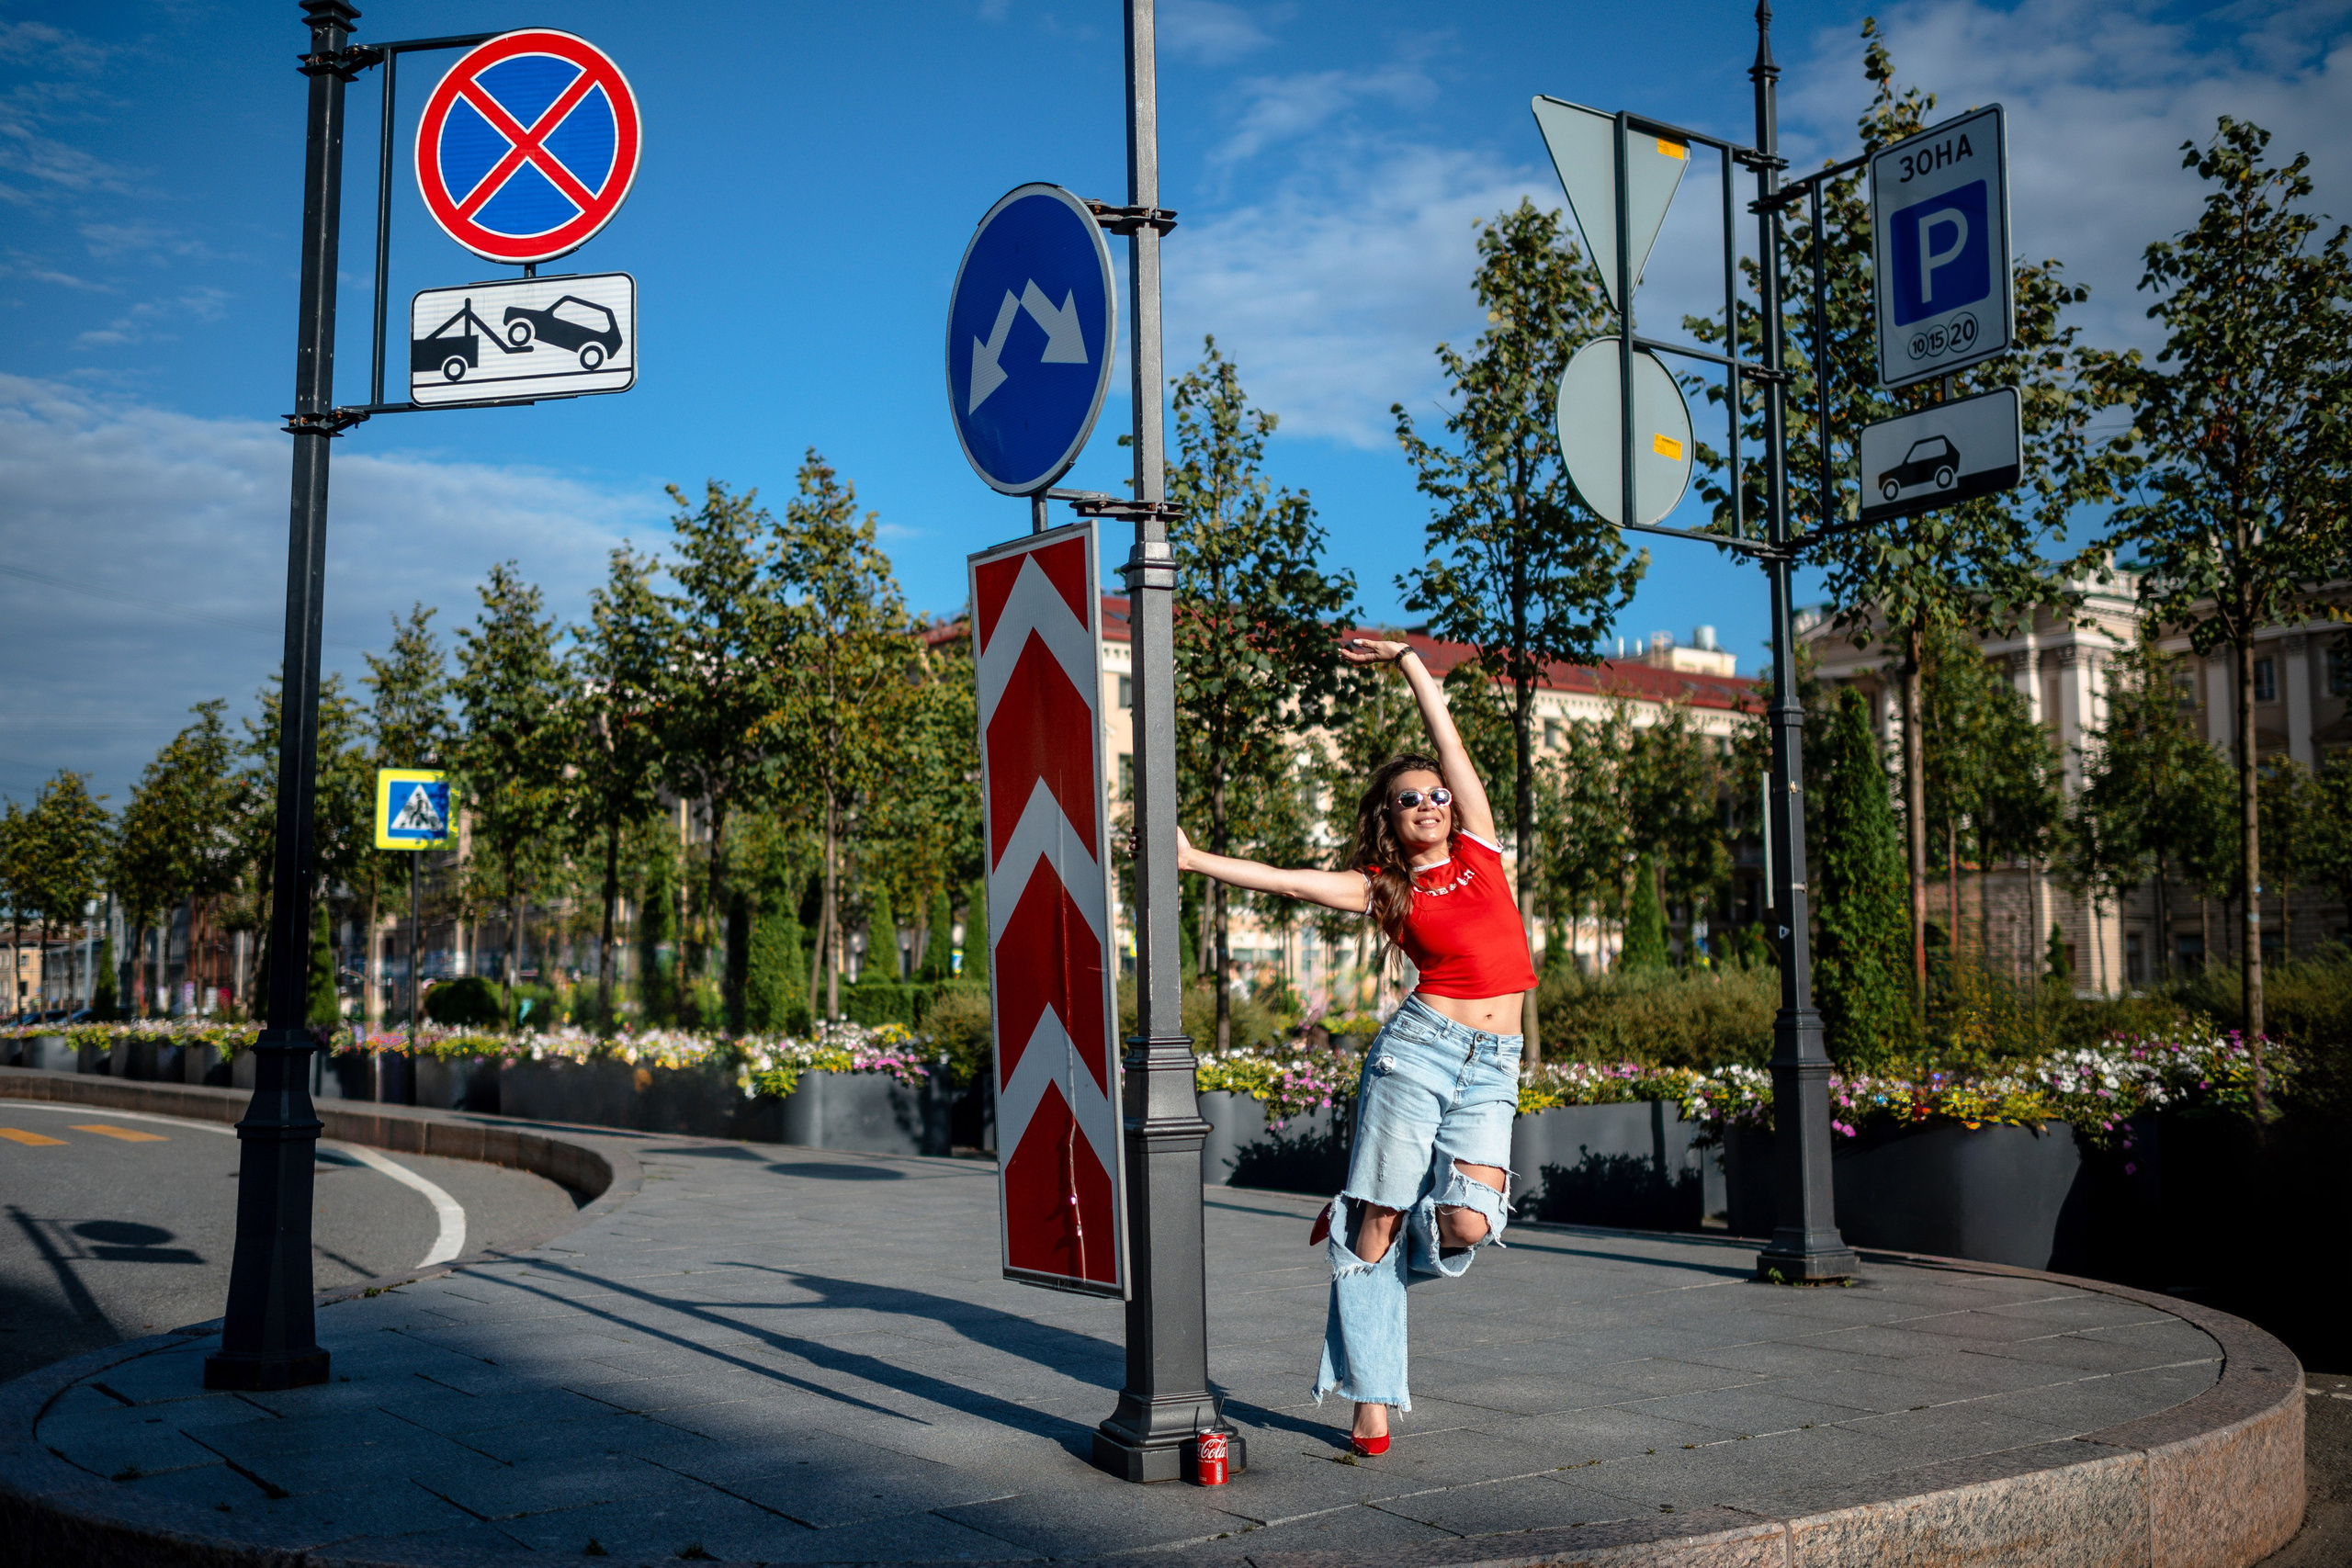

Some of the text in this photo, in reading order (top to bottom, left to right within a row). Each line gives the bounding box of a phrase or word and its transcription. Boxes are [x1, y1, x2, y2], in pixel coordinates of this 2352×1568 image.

[1899, 133, 1973, 183] ЗОНА
[1918, 208, 1969, 304] P
[1912, 319, 1975, 355] 10 15 20
[1201, 1438, 1227, 1459] Cola
